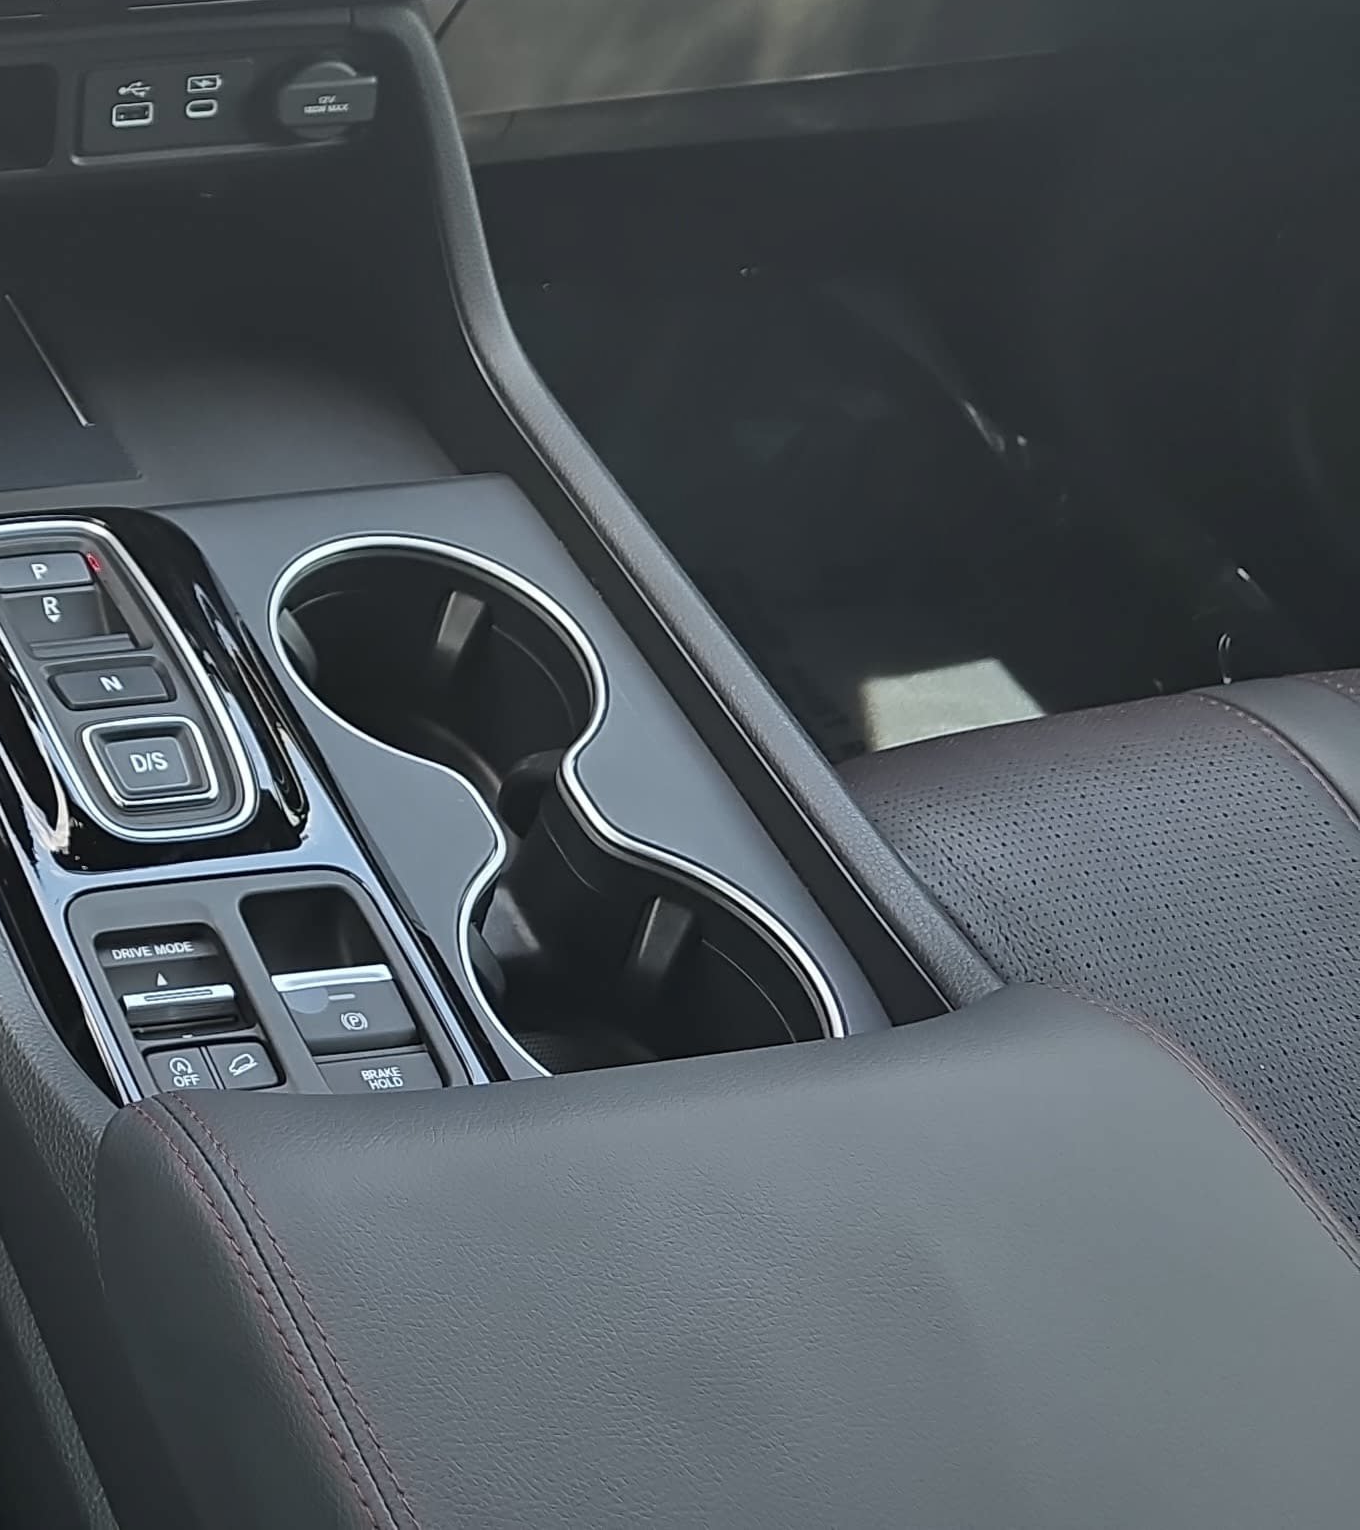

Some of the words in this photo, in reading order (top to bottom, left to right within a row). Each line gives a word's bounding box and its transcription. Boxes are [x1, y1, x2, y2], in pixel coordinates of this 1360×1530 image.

[31, 563, 47, 579] P
[42, 597, 59, 615] R
[99, 676, 123, 692] N
[129, 752, 169, 771] D/S
[111, 945, 151, 961] DRIVE
[154, 941, 194, 956] MODE
[173, 1074, 200, 1086] OFF
[361, 1067, 402, 1081] BRAKE
[368, 1077, 405, 1089] HOLD
